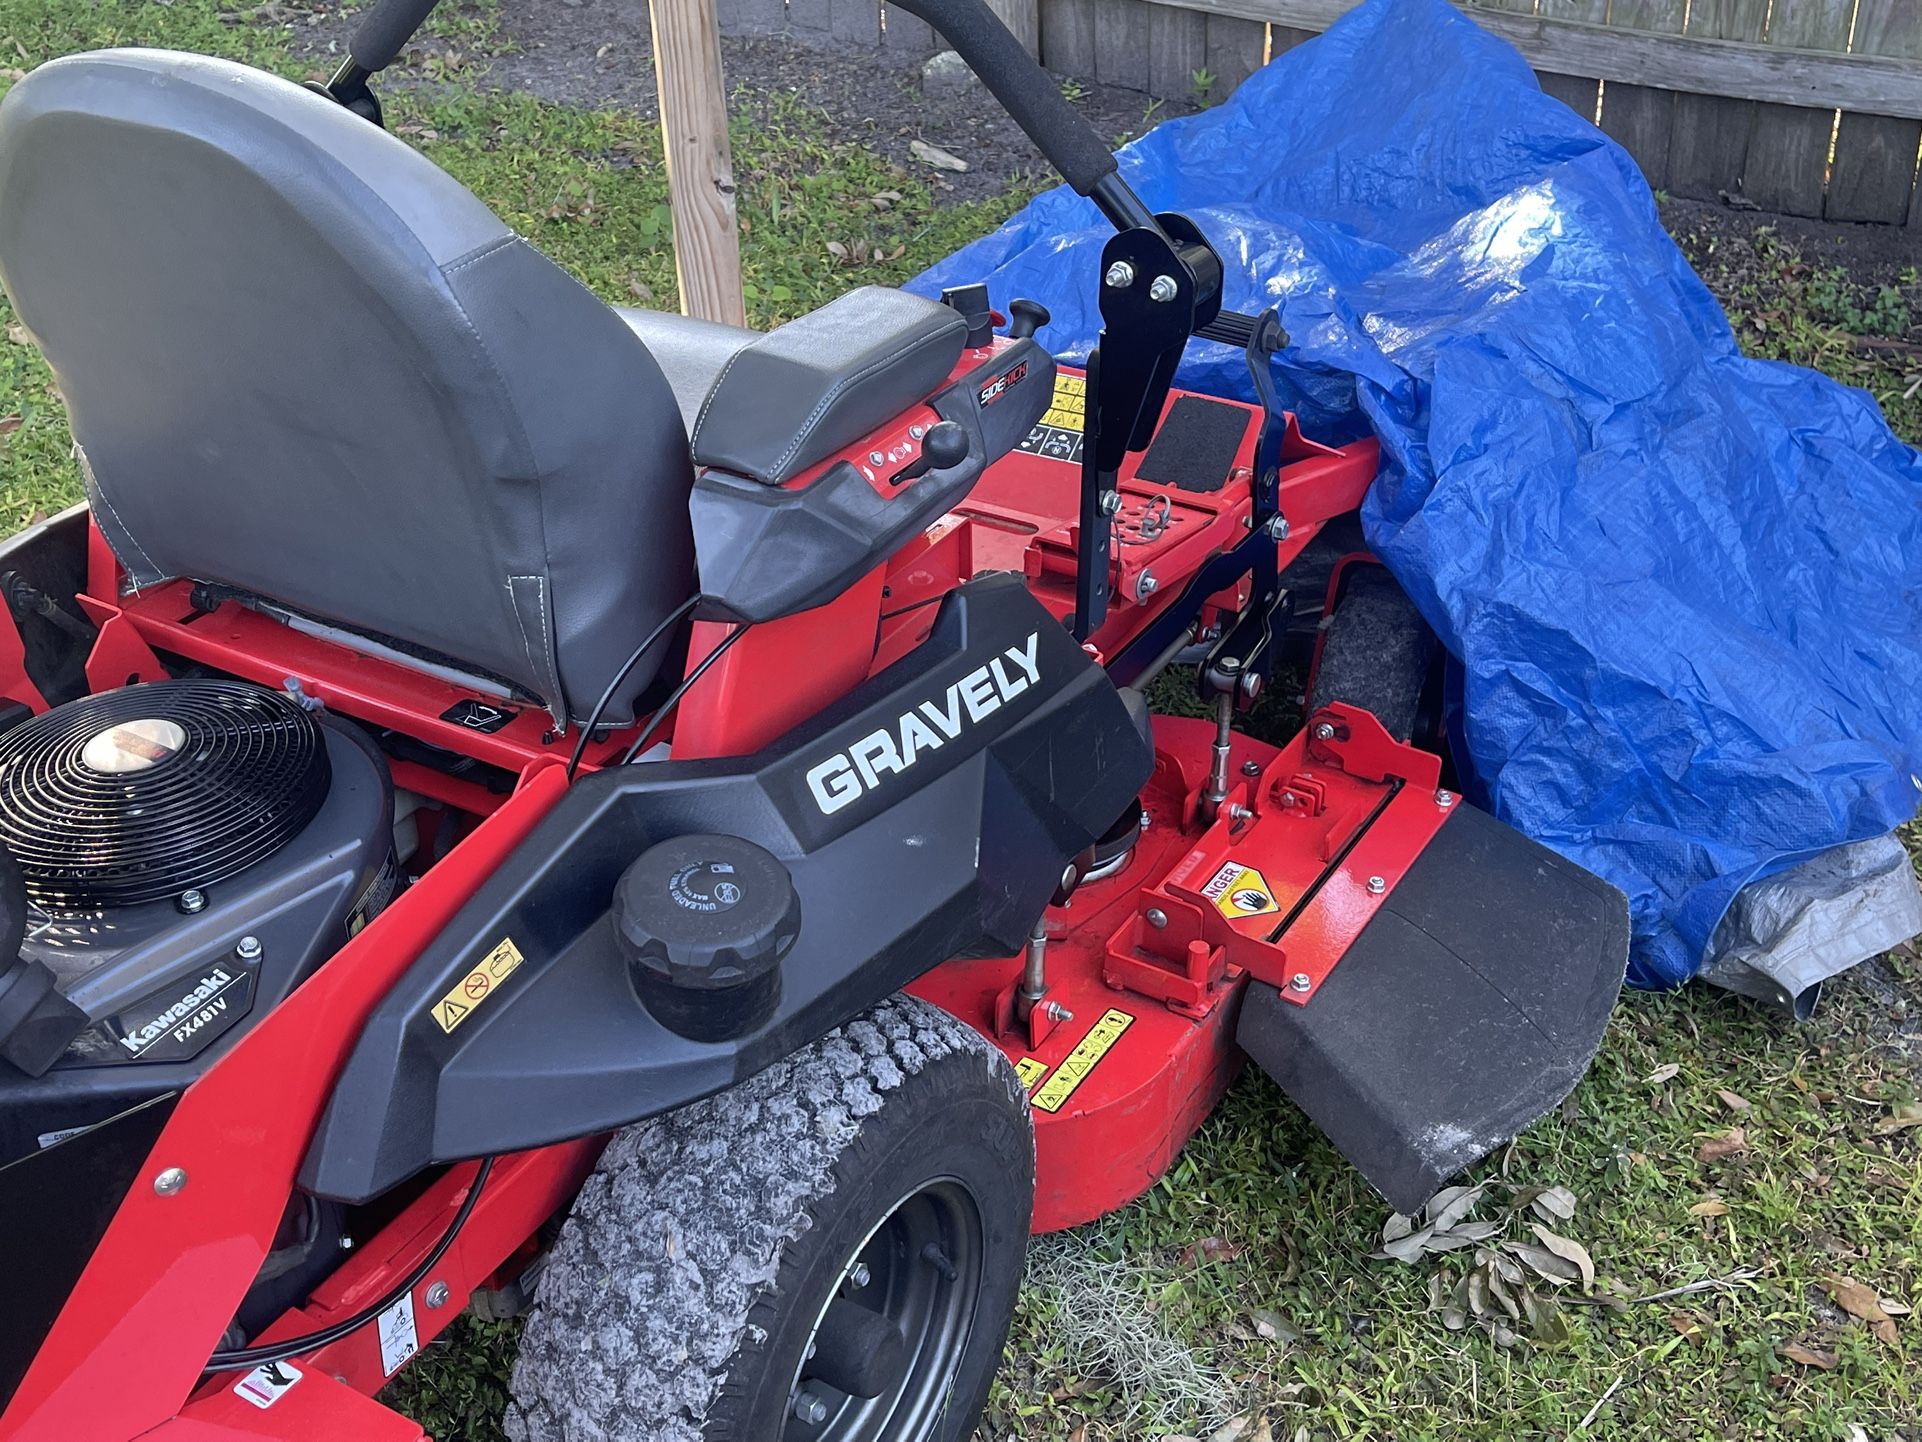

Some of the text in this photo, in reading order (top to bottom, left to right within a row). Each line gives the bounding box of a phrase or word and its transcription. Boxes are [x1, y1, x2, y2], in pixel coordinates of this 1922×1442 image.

[806, 631, 1040, 815] GRAVELY
[671, 889, 717, 911] UNLEADED
[1206, 867, 1240, 899] NGER
[119, 968, 232, 1052] Kawasaki
[173, 996, 227, 1043] FX481V
